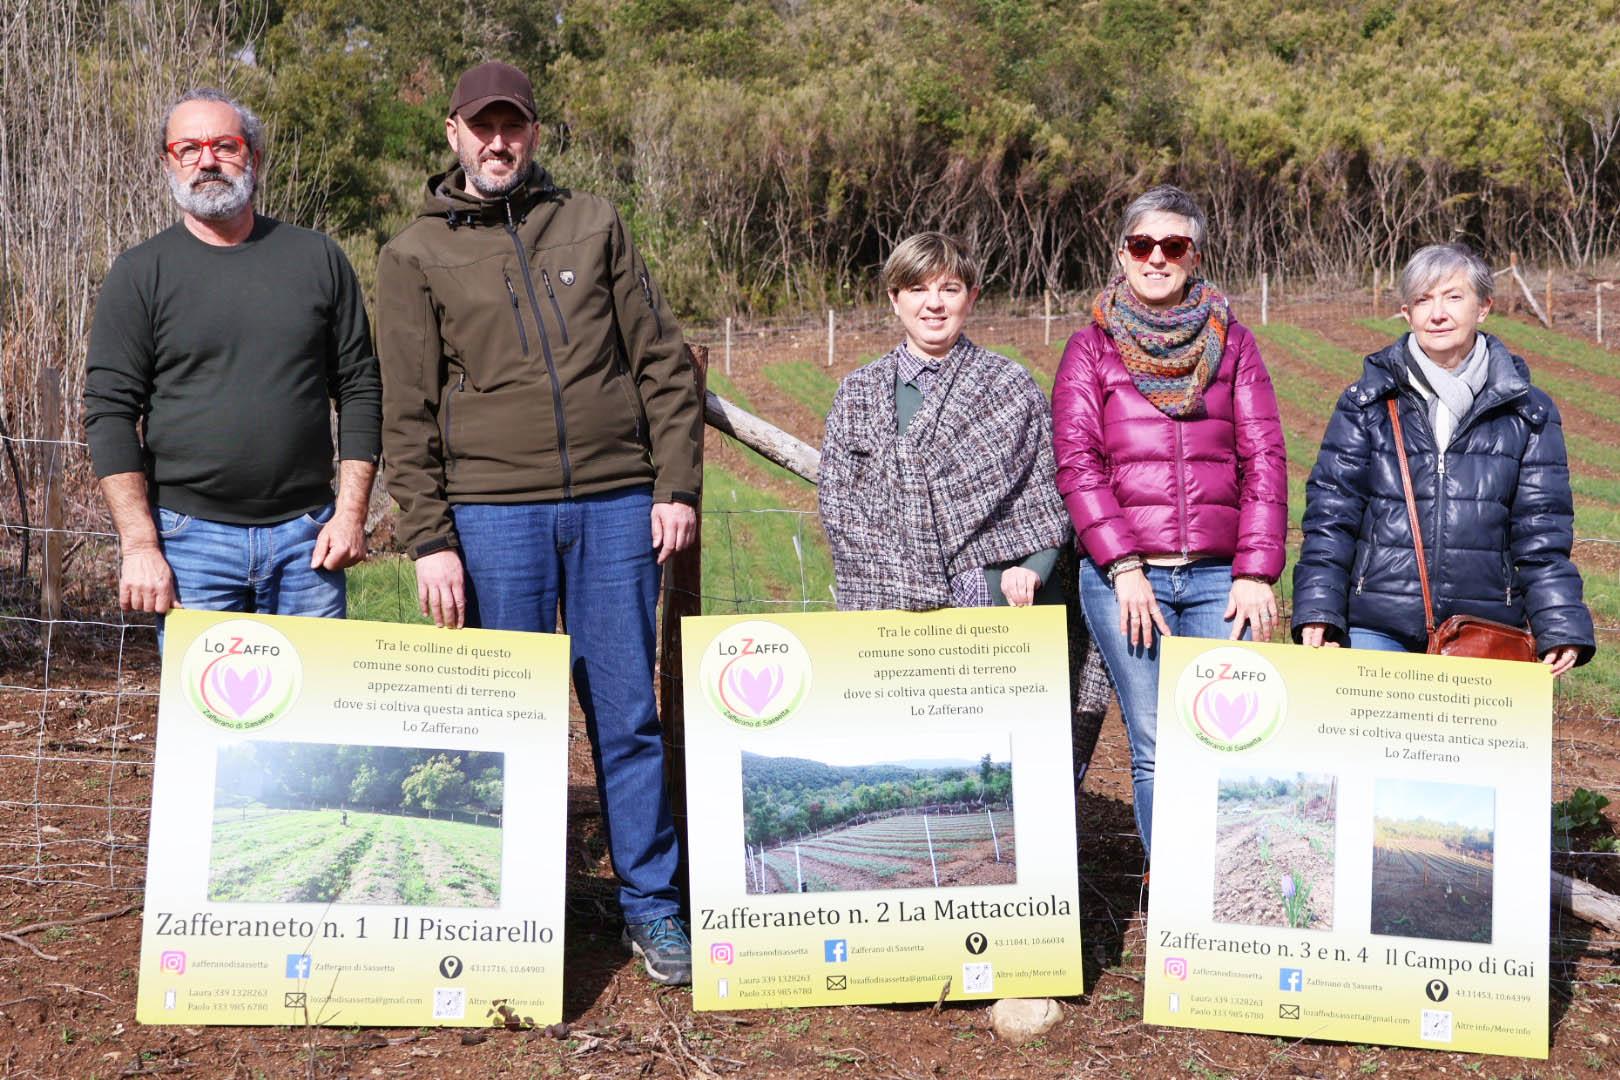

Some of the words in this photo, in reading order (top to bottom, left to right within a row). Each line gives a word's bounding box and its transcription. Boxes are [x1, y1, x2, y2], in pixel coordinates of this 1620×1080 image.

[877, 625, 897, 638] Tra
[900, 624, 912, 637] le
[914, 623, 952, 637] colline
[955, 623, 968, 635] di
[970, 623, 1010, 638] questo
[376, 639, 396, 652] Tra
[399, 640, 411, 653] le
[413, 641, 453, 656] colline
[456, 644, 468, 656] di
[471, 646, 512, 662] questo
[858, 647, 905, 658] comune
[907, 647, 936, 657] sono
[938, 643, 989, 656] custoditi
[992, 642, 1030, 658] piccoli
[353, 660, 402, 672] comune
[404, 662, 434, 673] sono
[437, 661, 489, 677] custoditi
[492, 666, 532, 682] piccoli
[873, 664, 956, 680] appezzamenti
[959, 663, 971, 675] di
[973, 664, 1016, 675] terreno
[1357, 666, 1378, 678] Tra
[1380, 666, 1391, 678] le
[1394, 668, 1434, 682] colline
[1437, 671, 1449, 683] di
[1452, 674, 1492, 689] questo
[367, 681, 453, 696] appezzamenti
[457, 682, 469, 695] di
[471, 685, 516, 698] terreno
[843, 687, 872, 699] dove
[875, 687, 885, 698] si
[887, 685, 926, 698] coltiva
[928, 685, 968, 699] questa
[970, 683, 1006, 695] antica
[1008, 682, 1049, 698] spezia.
[1336, 686, 1383, 698] comune
[1386, 688, 1415, 700] sono
[1418, 690, 1470, 704] custoditi
[1473, 694, 1513, 710] piccoli
[333, 697, 363, 711] dove
[366, 699, 377, 711] si
[379, 699, 420, 714] coltiva
[423, 704, 463, 719] questa
[467, 704, 503, 718] antica
[506, 707, 547, 723] spezia.
[723, 710, 754, 728] Zafferano
[763, 708, 790, 727] Sassetta
[911, 705, 926, 716] Lo
[928, 703, 984, 716] Zafferano
[1350, 705, 1433, 723] appezzamenti
[1436, 709, 1449, 722] di
[1452, 713, 1497, 726] terreno
[203, 709, 234, 728] Zafferano
[244, 712, 274, 728] Sassetta
[403, 721, 418, 733] Lo
[420, 721, 479, 735] Zafferano
[1195, 732, 1225, 751] Zafferano
[1234, 736, 1262, 752] Sassetta
[1318, 723, 1346, 736] dove
[1349, 726, 1359, 737] si
[1362, 725, 1402, 740] coltiva
[1405, 731, 1445, 746] questa
[1447, 732, 1484, 745] antica
[1487, 735, 1529, 751] spezia.
[1385, 747, 1399, 759] Lo
[1402, 747, 1460, 763] Zafferano
[701, 907, 840, 930] Zafferaneto
[848, 908, 869, 925] n.
[877, 903, 890, 923] 2
[899, 902, 926, 922] La
[934, 895, 1071, 922] Mattacciola
[156, 912, 314, 938] Zafferaneto
[324, 921, 345, 938] n.
[356, 917, 369, 939] 1
[392, 917, 409, 940] Il
[419, 917, 554, 944] Pisciarello
[850, 946, 887, 954] Zafferano
[895, 944, 925, 952] Sassetta
[1160, 929, 1271, 957] Zafferaneto
[1277, 944, 1295, 958] n.
[1300, 940, 1311, 959] 3
[1318, 947, 1329, 960] e
[1334, 948, 1351, 962] n.
[1357, 945, 1369, 964] 4
[1385, 948, 1398, 966] Il
[1403, 949, 1472, 975] Campo
[1479, 955, 1497, 974] di
[1503, 957, 1535, 978] Gai
[362, 963, 395, 972] Sassetta
[738, 977, 760, 985] Laura
[1306, 977, 1341, 989] Zafferano
[1352, 981, 1383, 991] Sassetta
[189, 989, 212, 997] Laura
[739, 990, 760, 998] Paolo
[1190, 995, 1212, 1003] Laura
[188, 1003, 210, 1011] Paolo
[1190, 1007, 1211, 1016] Paolo
